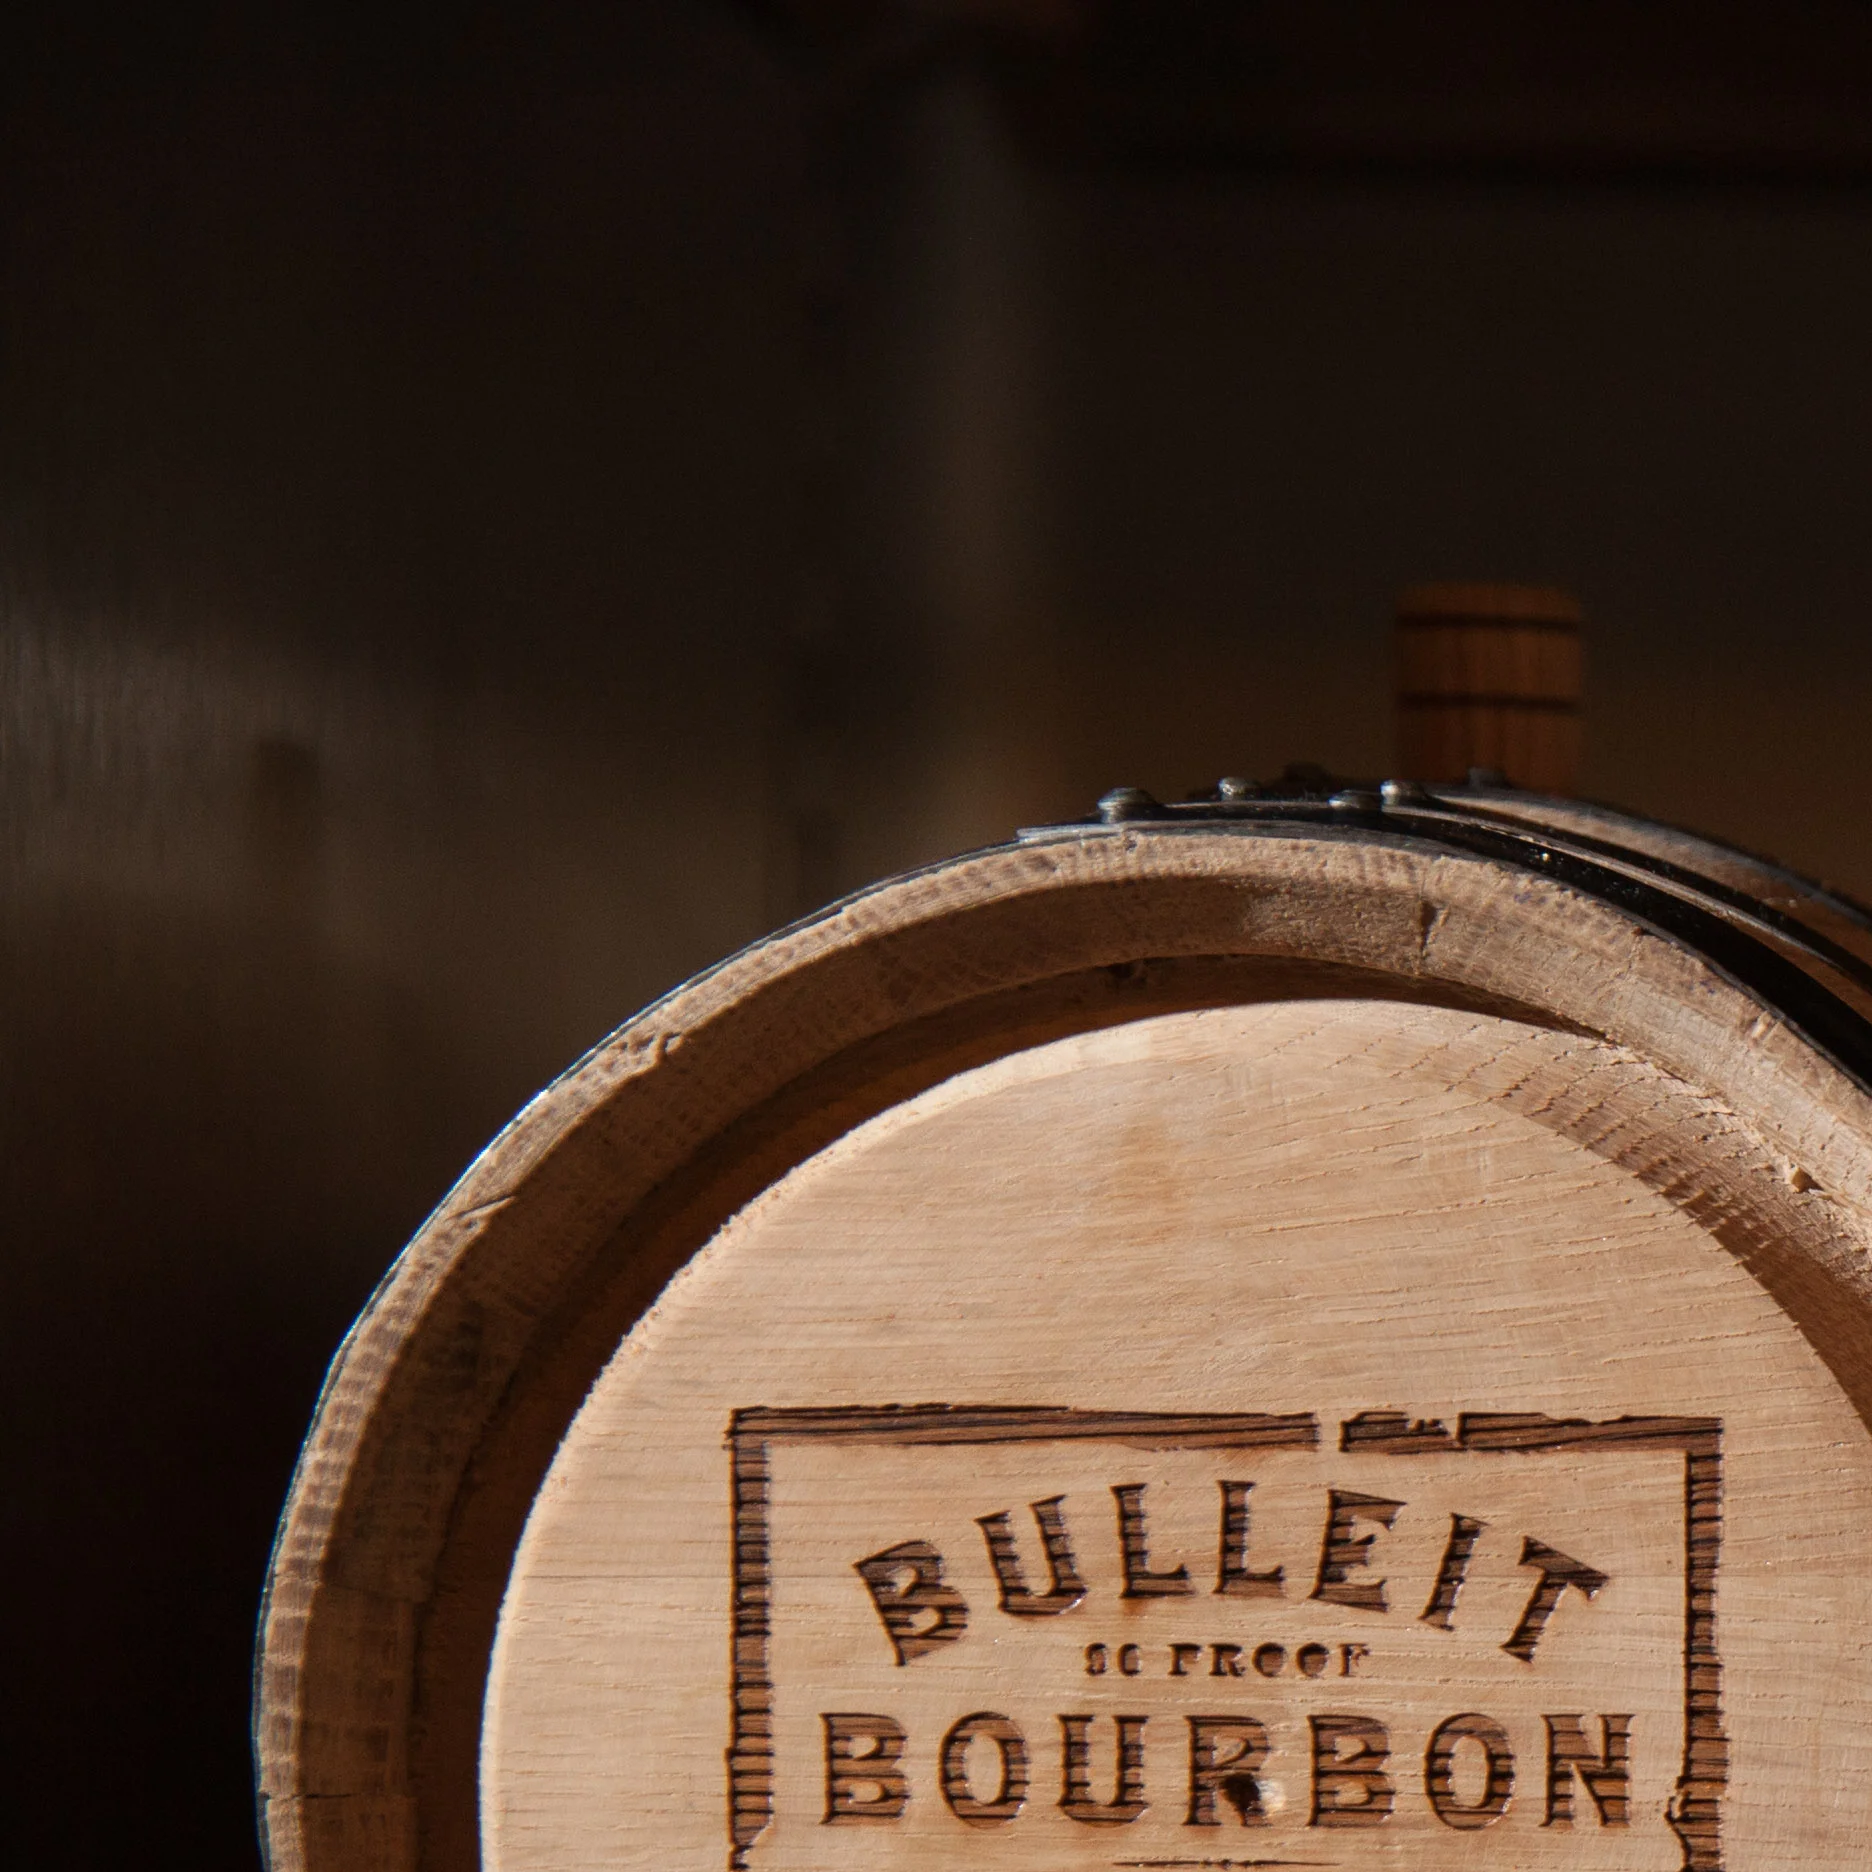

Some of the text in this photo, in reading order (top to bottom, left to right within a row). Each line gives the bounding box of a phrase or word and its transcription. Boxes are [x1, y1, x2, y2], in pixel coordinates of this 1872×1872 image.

[853, 1480, 1611, 1665] BULLEIT
[1167, 1642, 1370, 1677] PROOF
[821, 1711, 1635, 1828] BOURBON
